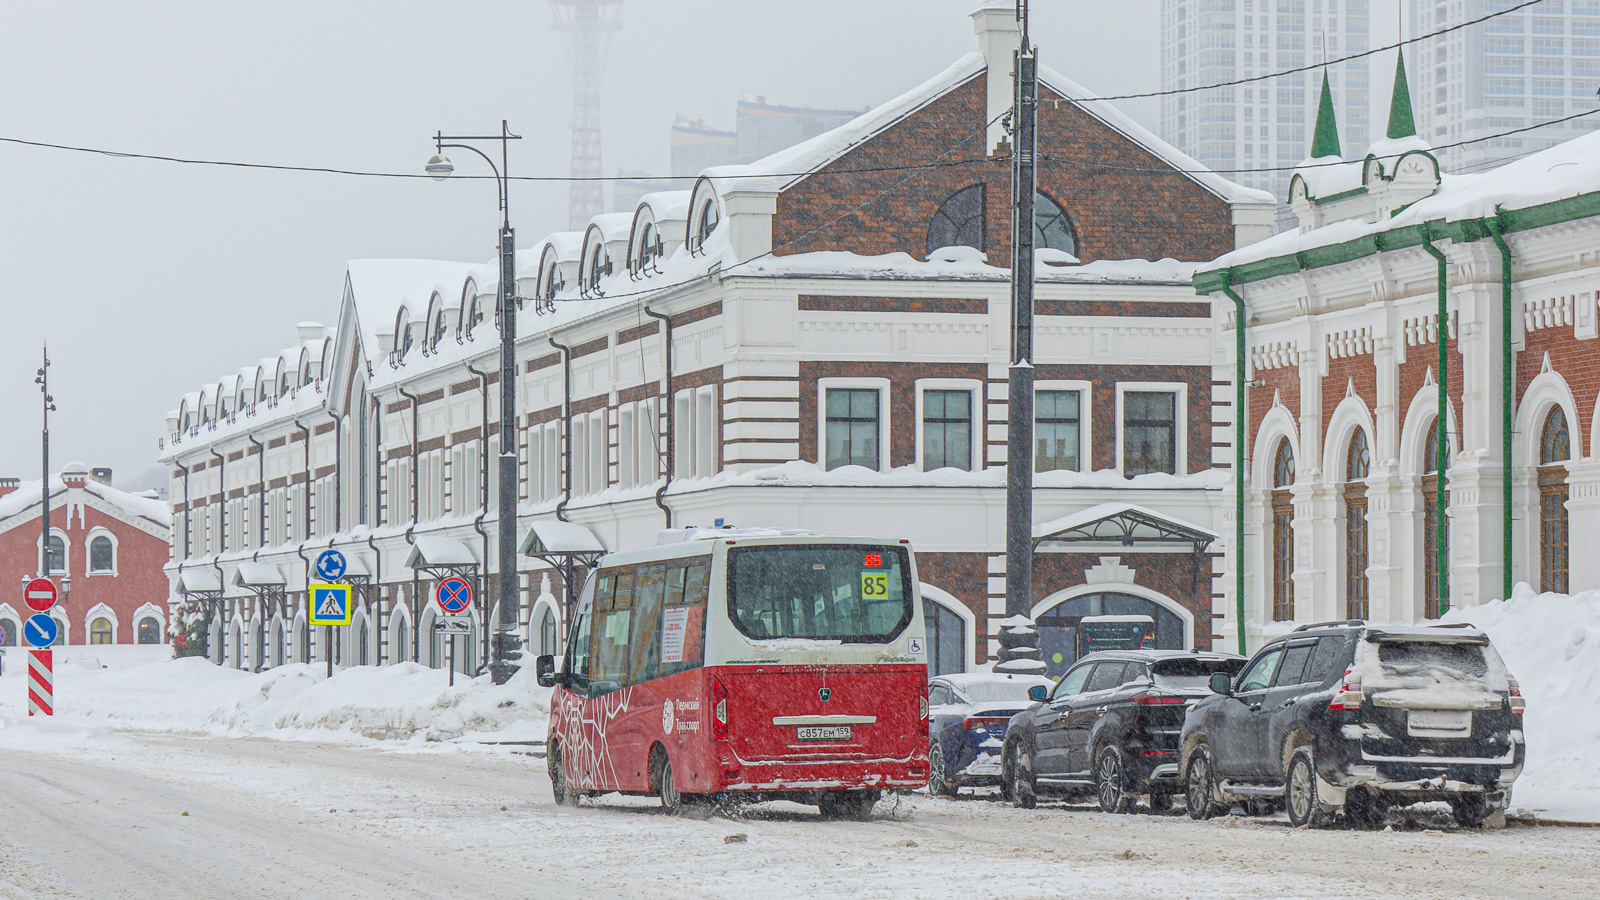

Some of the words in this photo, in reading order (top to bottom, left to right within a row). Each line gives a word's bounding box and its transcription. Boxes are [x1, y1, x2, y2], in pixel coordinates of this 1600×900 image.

[864, 553, 882, 567] 85
[863, 577, 886, 595] 85
[675, 697, 699, 714] Пермский
[675, 718, 700, 734] Транспорт
